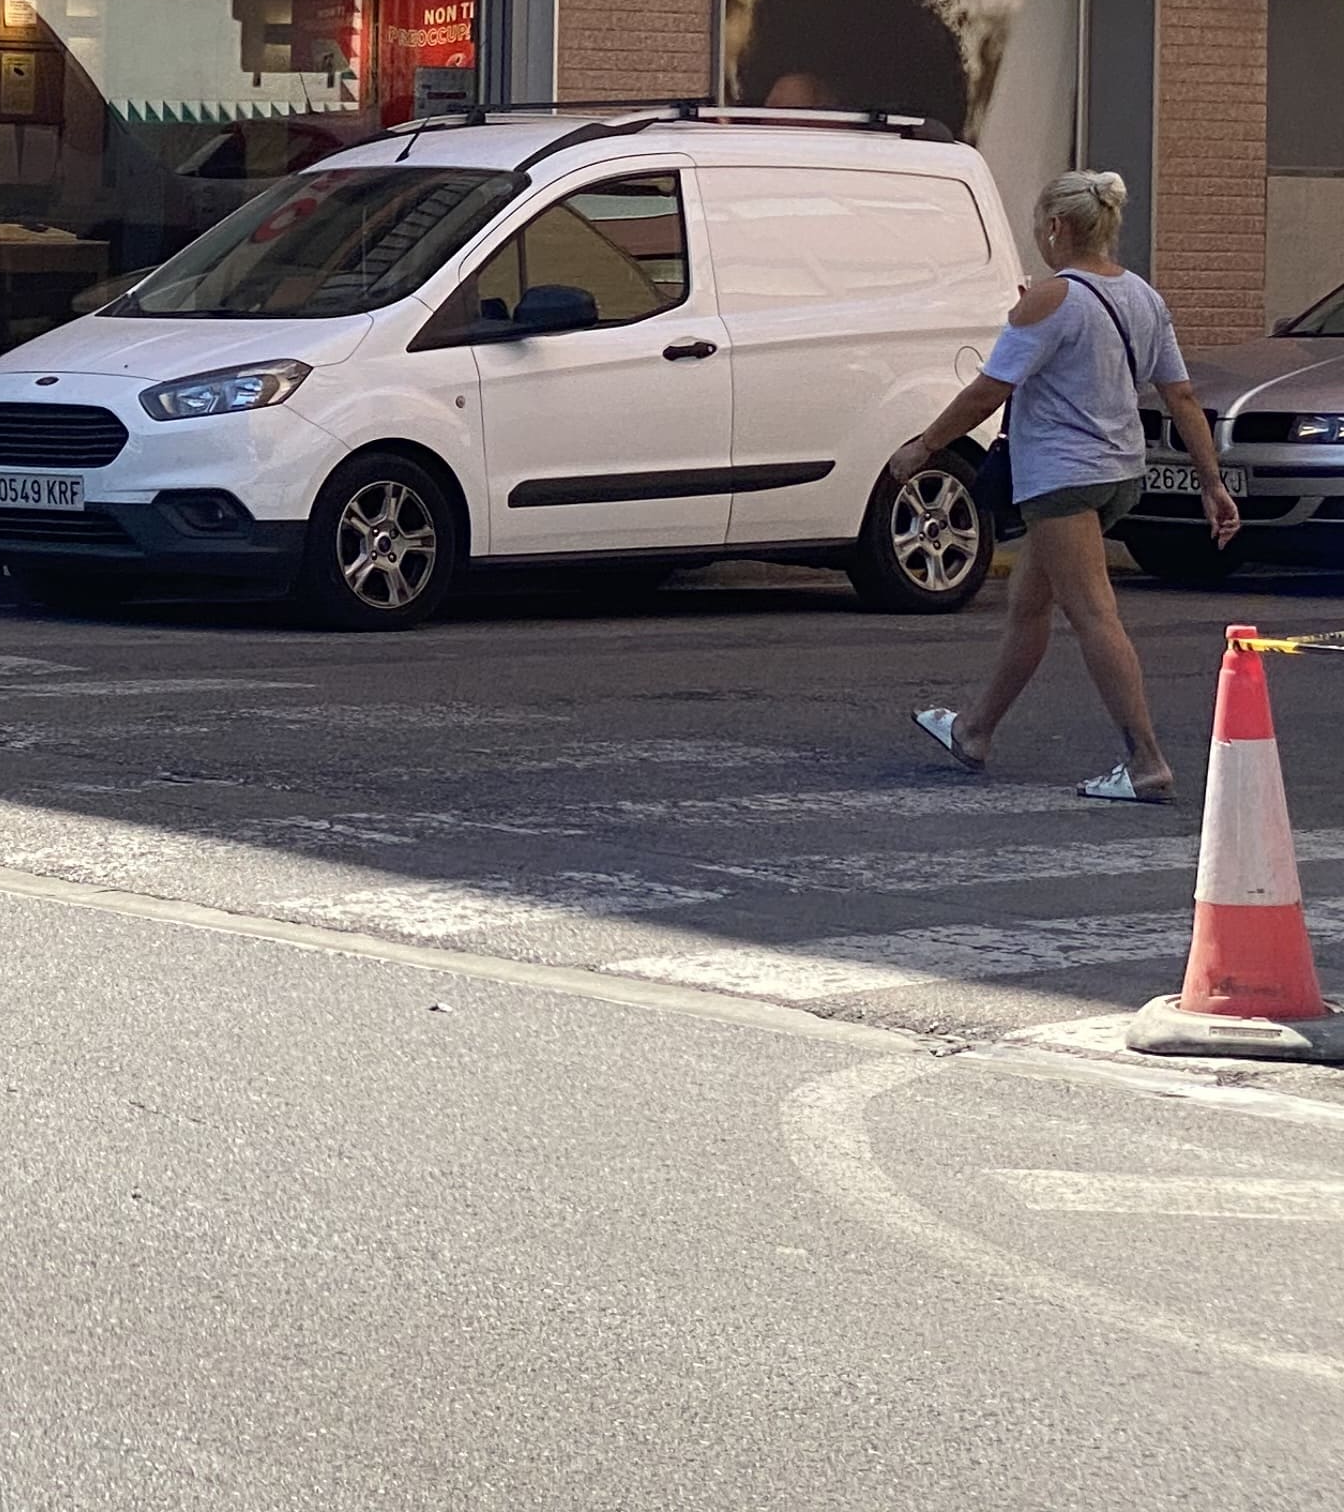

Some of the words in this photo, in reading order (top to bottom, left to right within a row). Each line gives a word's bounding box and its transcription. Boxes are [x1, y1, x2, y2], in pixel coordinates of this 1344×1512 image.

[424, 5, 456, 25] NON
[461, 1, 475, 19] TI
[46, 479, 81, 505] KRF
